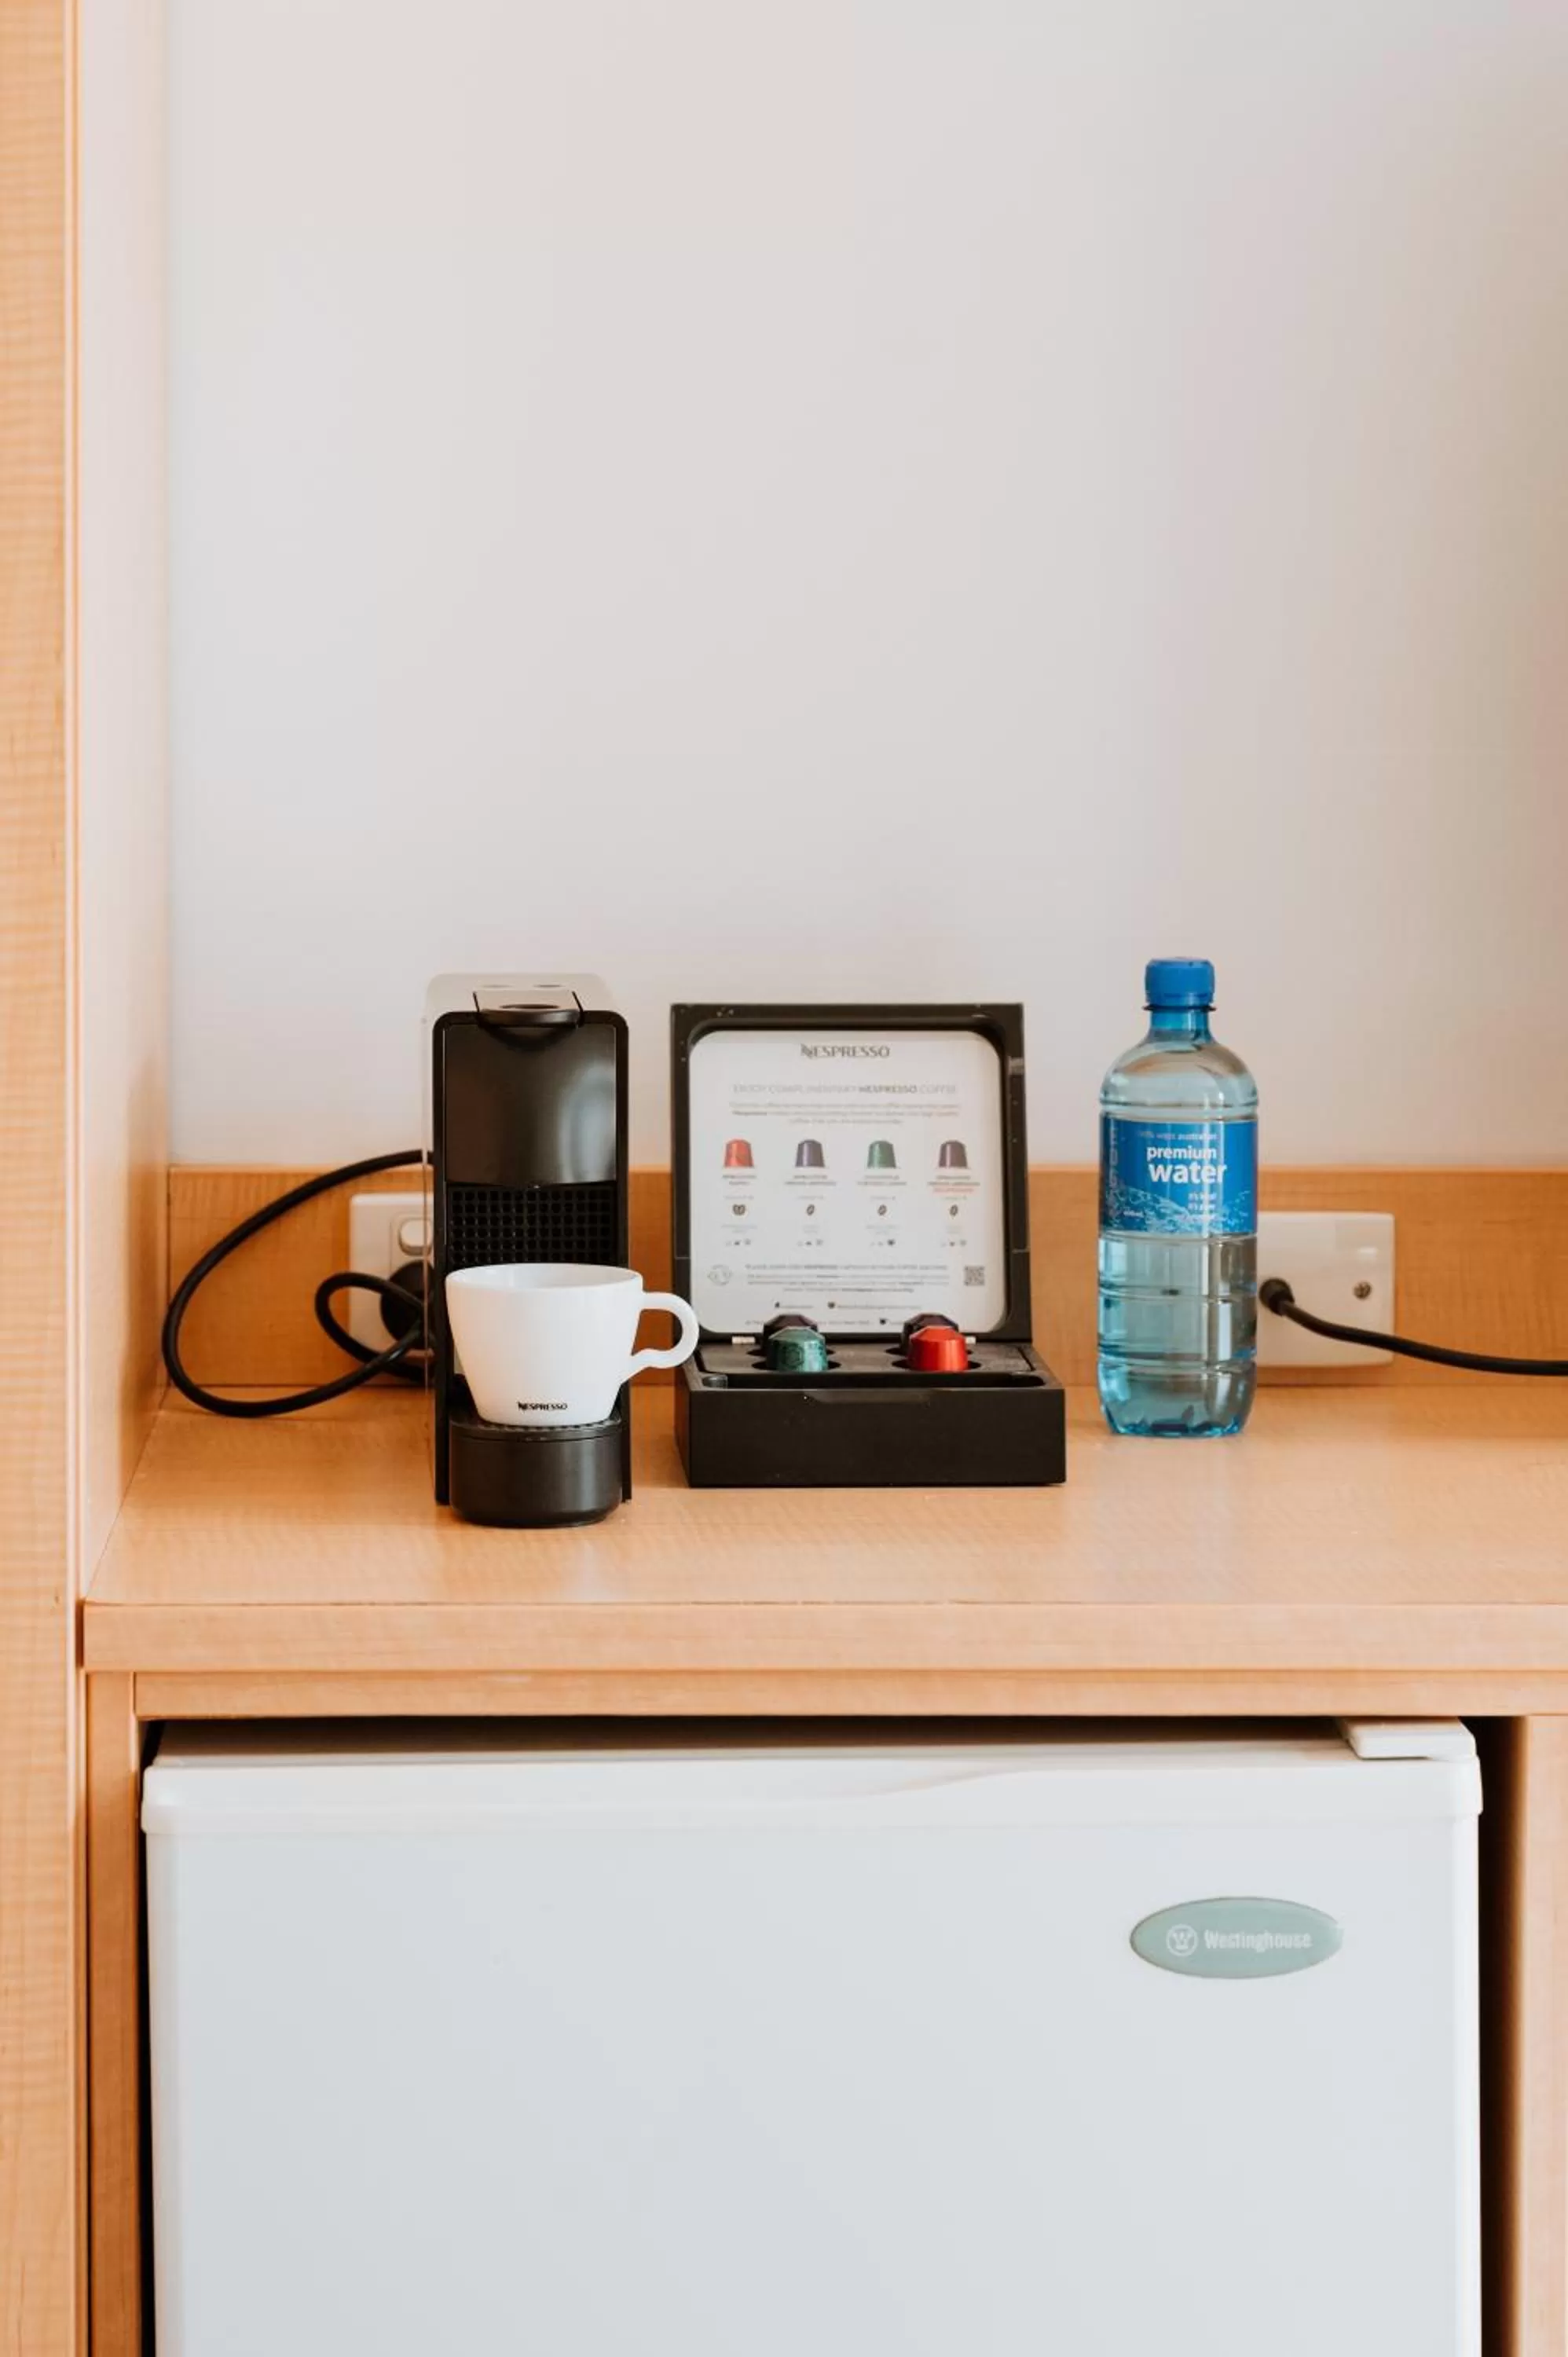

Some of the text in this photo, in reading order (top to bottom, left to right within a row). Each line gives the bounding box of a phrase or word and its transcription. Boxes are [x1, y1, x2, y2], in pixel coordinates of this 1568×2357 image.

[800, 1043, 891, 1060] NESPRESSO
[1146, 1146, 1217, 1162] premium
[1148, 1161, 1227, 1184] water
[517, 1401, 568, 1413] NESPRESSO
[1203, 1930, 1313, 1953] Westinghouse
